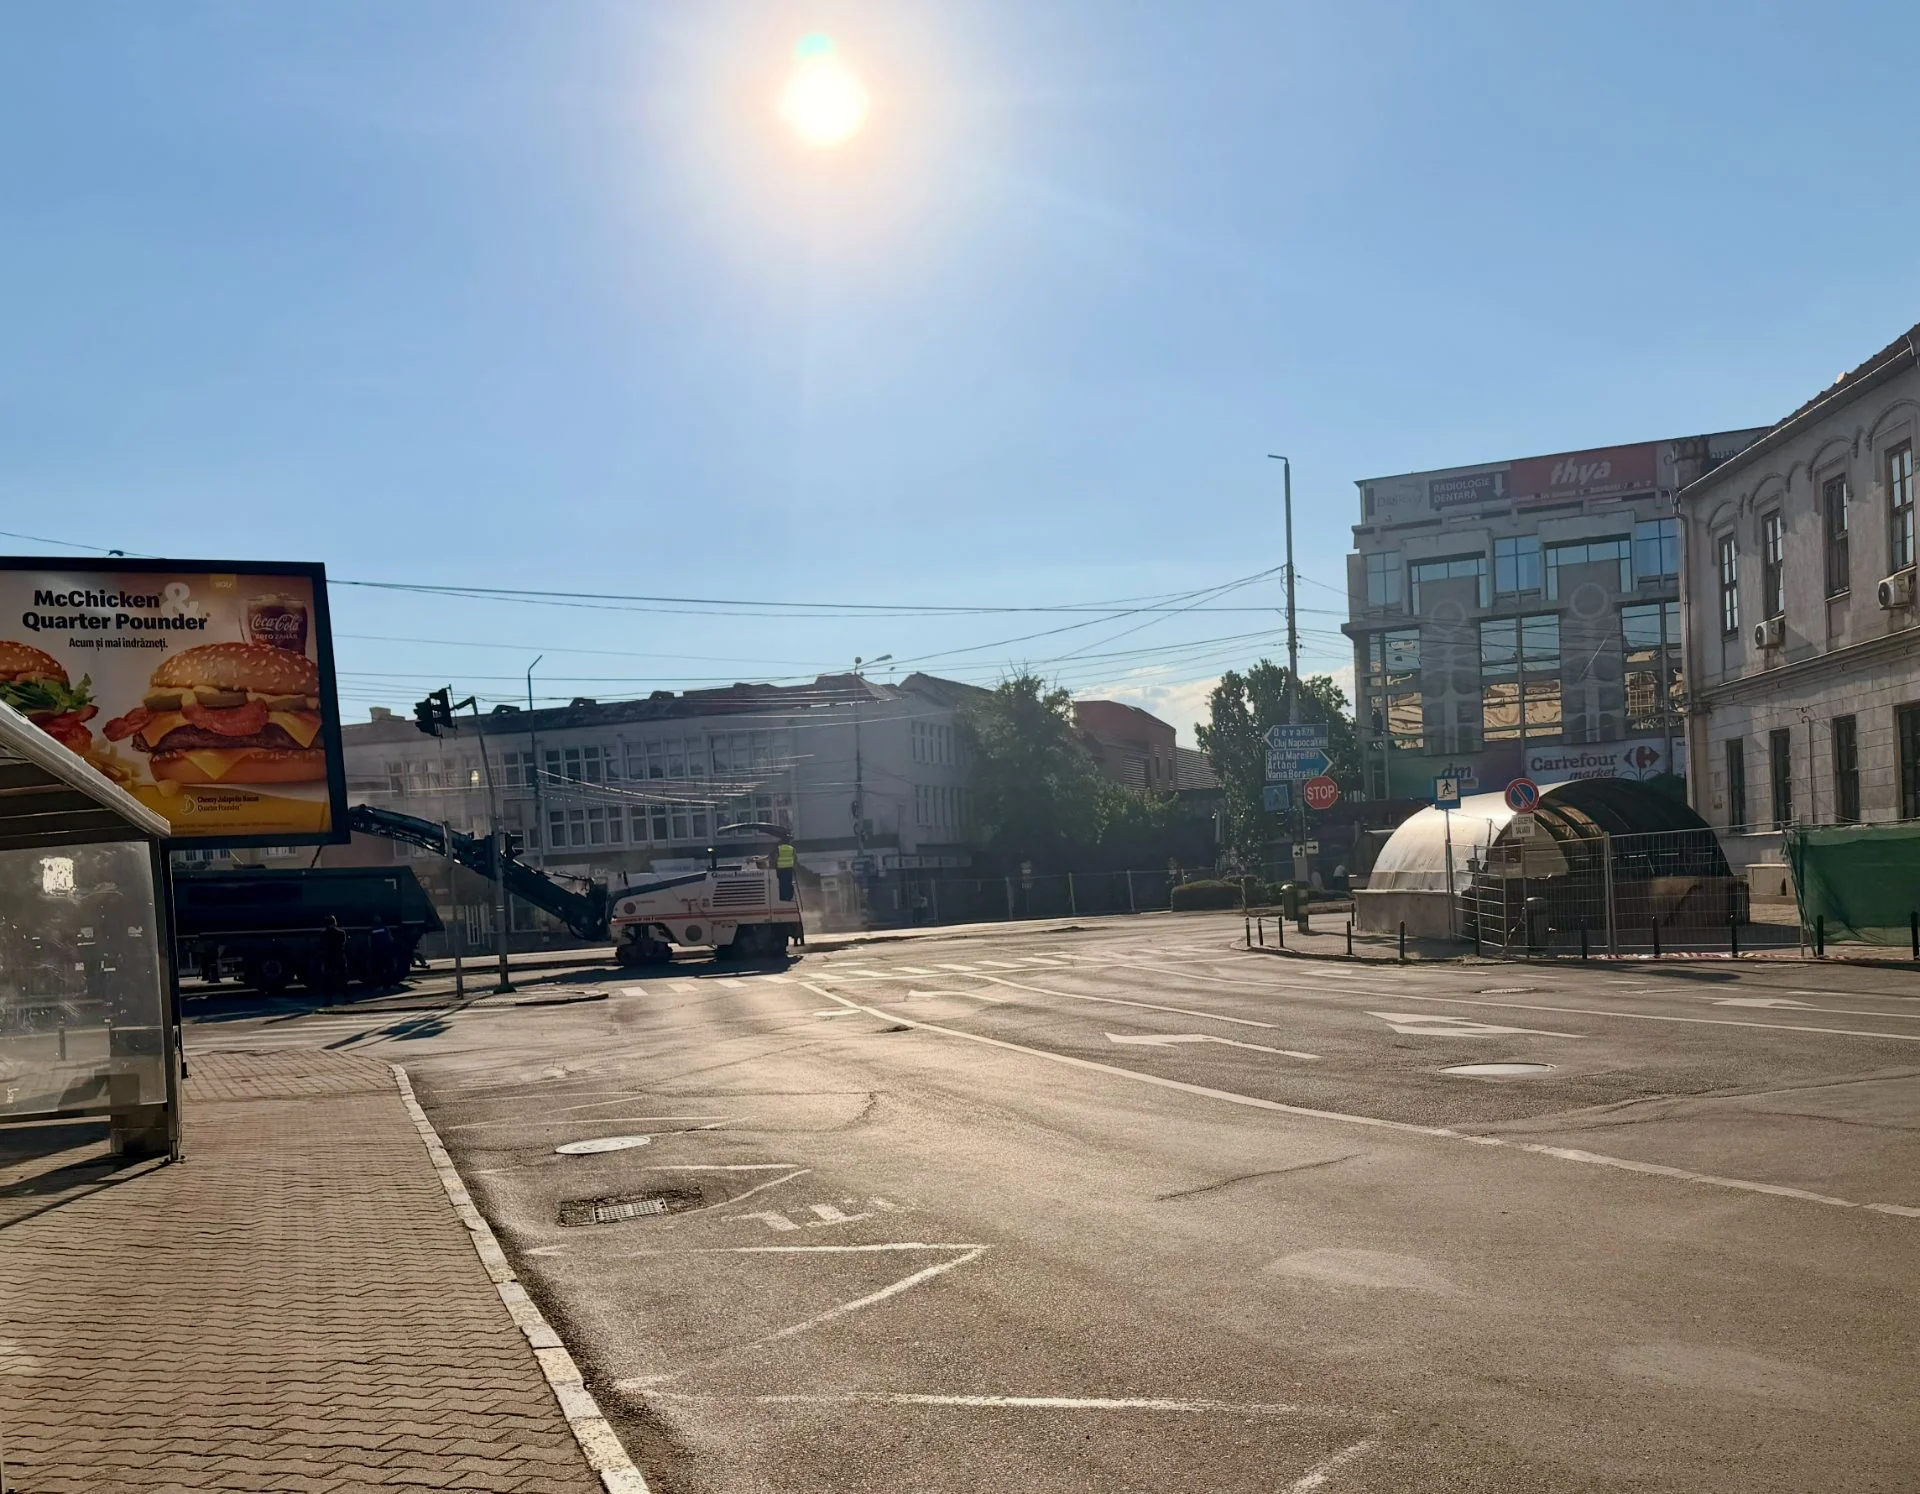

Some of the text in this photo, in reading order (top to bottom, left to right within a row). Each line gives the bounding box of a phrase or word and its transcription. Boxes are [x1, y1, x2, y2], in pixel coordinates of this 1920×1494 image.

[1550, 458, 1612, 486] thya
[1433, 478, 1490, 493] RADIOLOGIE
[34, 582, 199, 617] McChicken &
[22, 611, 207, 633] Quarter Pounder
[250, 613, 300, 631] Coca-Cola
[69, 637, 95, 648] Acum
[105, 637, 122, 649] mai
[1273, 727, 1301, 737] Deva
[1273, 738, 1287, 750] Cluj
[1267, 751, 1284, 761] Satu
[1285, 751, 1305, 760] Mare
[1530, 753, 1618, 772] Carrefour
[1267, 769, 1288, 779] Vama
[1441, 763, 1473, 779] dm
[1569, 766, 1619, 779] market
[1307, 785, 1335, 800] STOP
